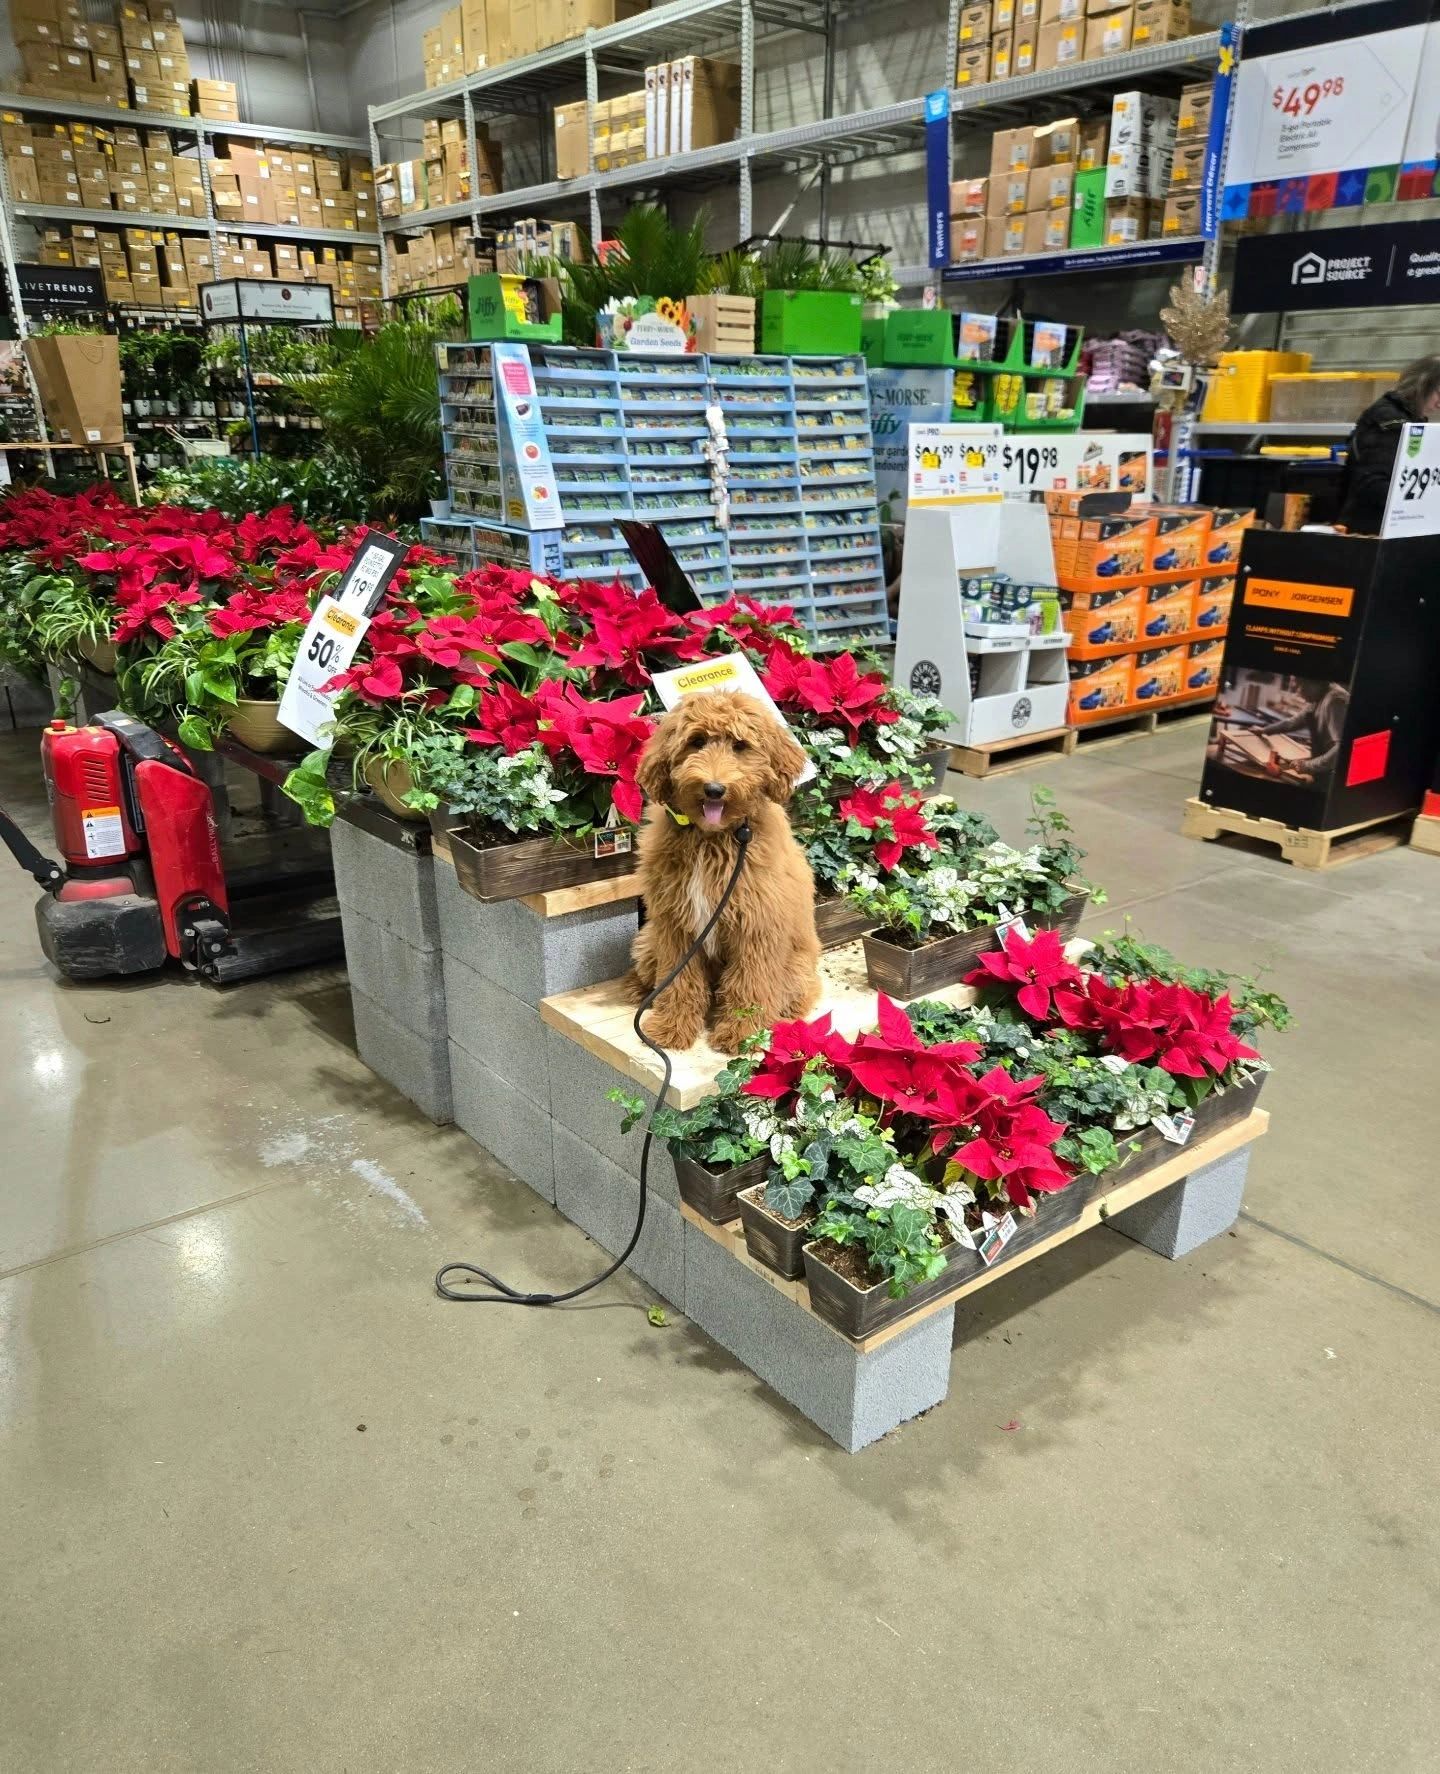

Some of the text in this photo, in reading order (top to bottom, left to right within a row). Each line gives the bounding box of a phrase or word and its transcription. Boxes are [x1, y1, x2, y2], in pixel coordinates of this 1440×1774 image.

[935, 211, 945, 259] Planters
[1328, 256, 1371, 270] PROJECT
[1326, 269, 1366, 281] SOURCE
[630, 337, 682, 347] Garden Seeds
[1252, 587, 1344, 606] PONY JORGENSEN
[327, 609, 356, 633] Clearance
[326, 664, 338, 675] OFF
[677, 666, 733, 689] Clearance
